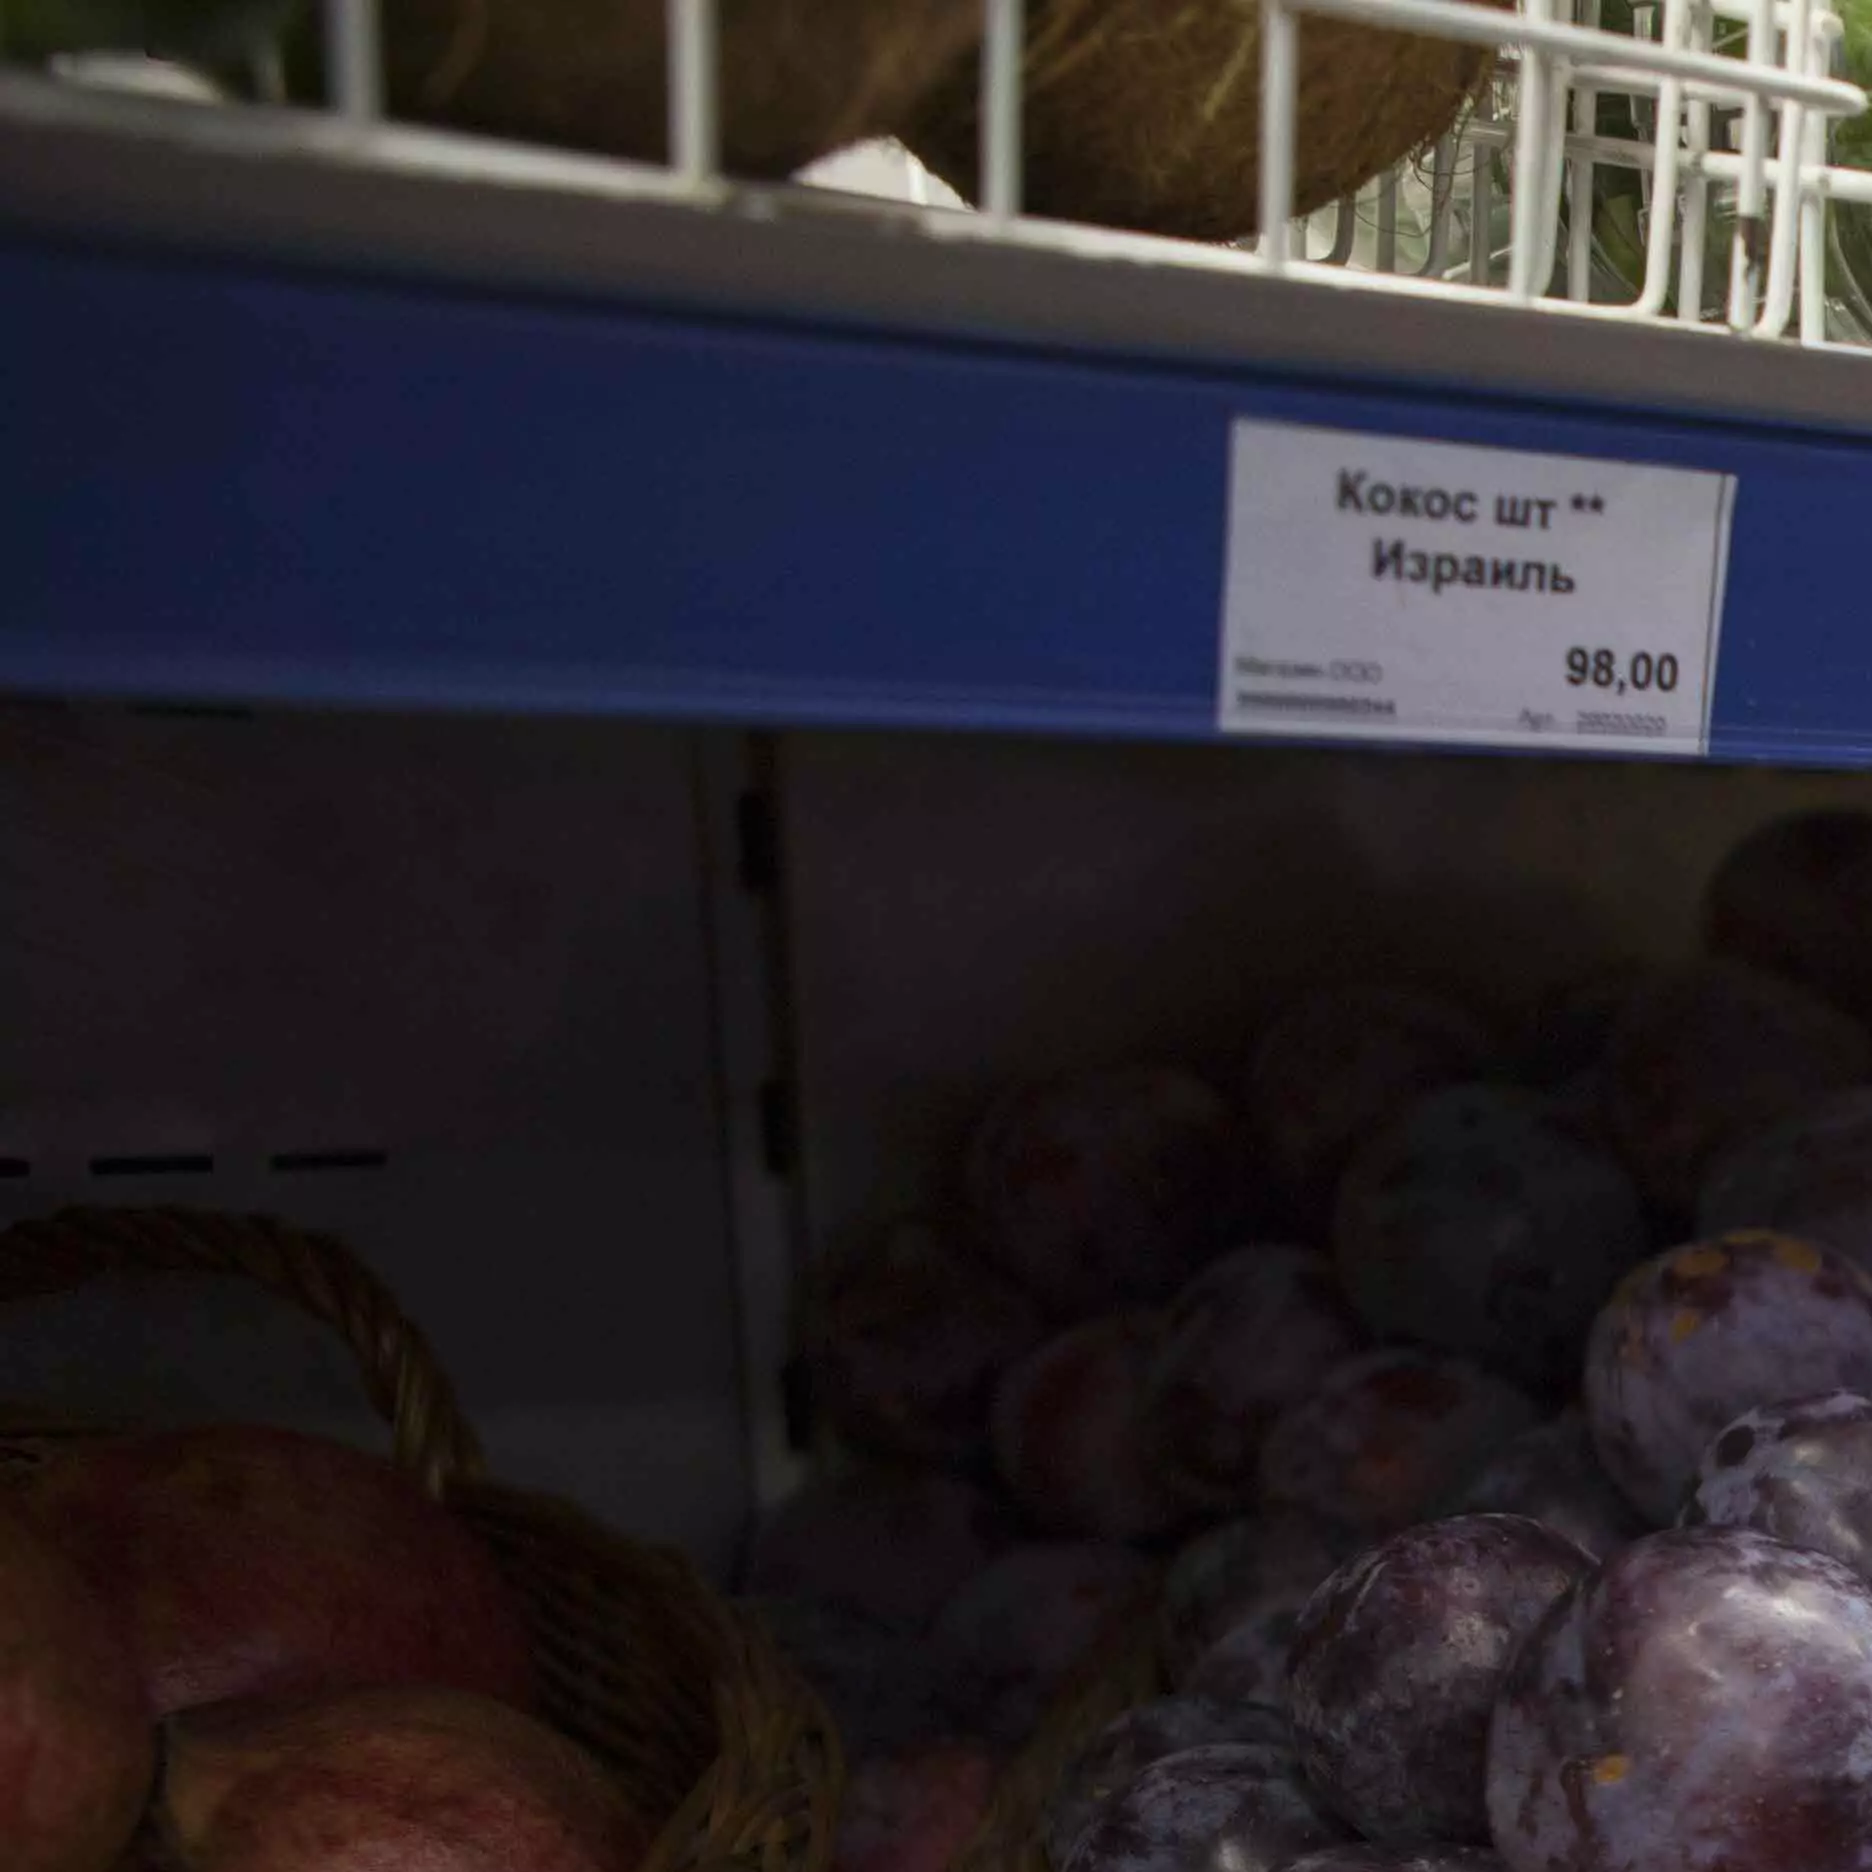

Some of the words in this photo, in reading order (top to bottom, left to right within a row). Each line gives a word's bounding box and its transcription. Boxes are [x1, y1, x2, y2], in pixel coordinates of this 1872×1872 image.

[1335, 467, 1479, 523] Кокос
[1495, 494, 1558, 530] шт
[1371, 538, 1576, 595] Израиль
[1565, 646, 1679, 696] 98,00
